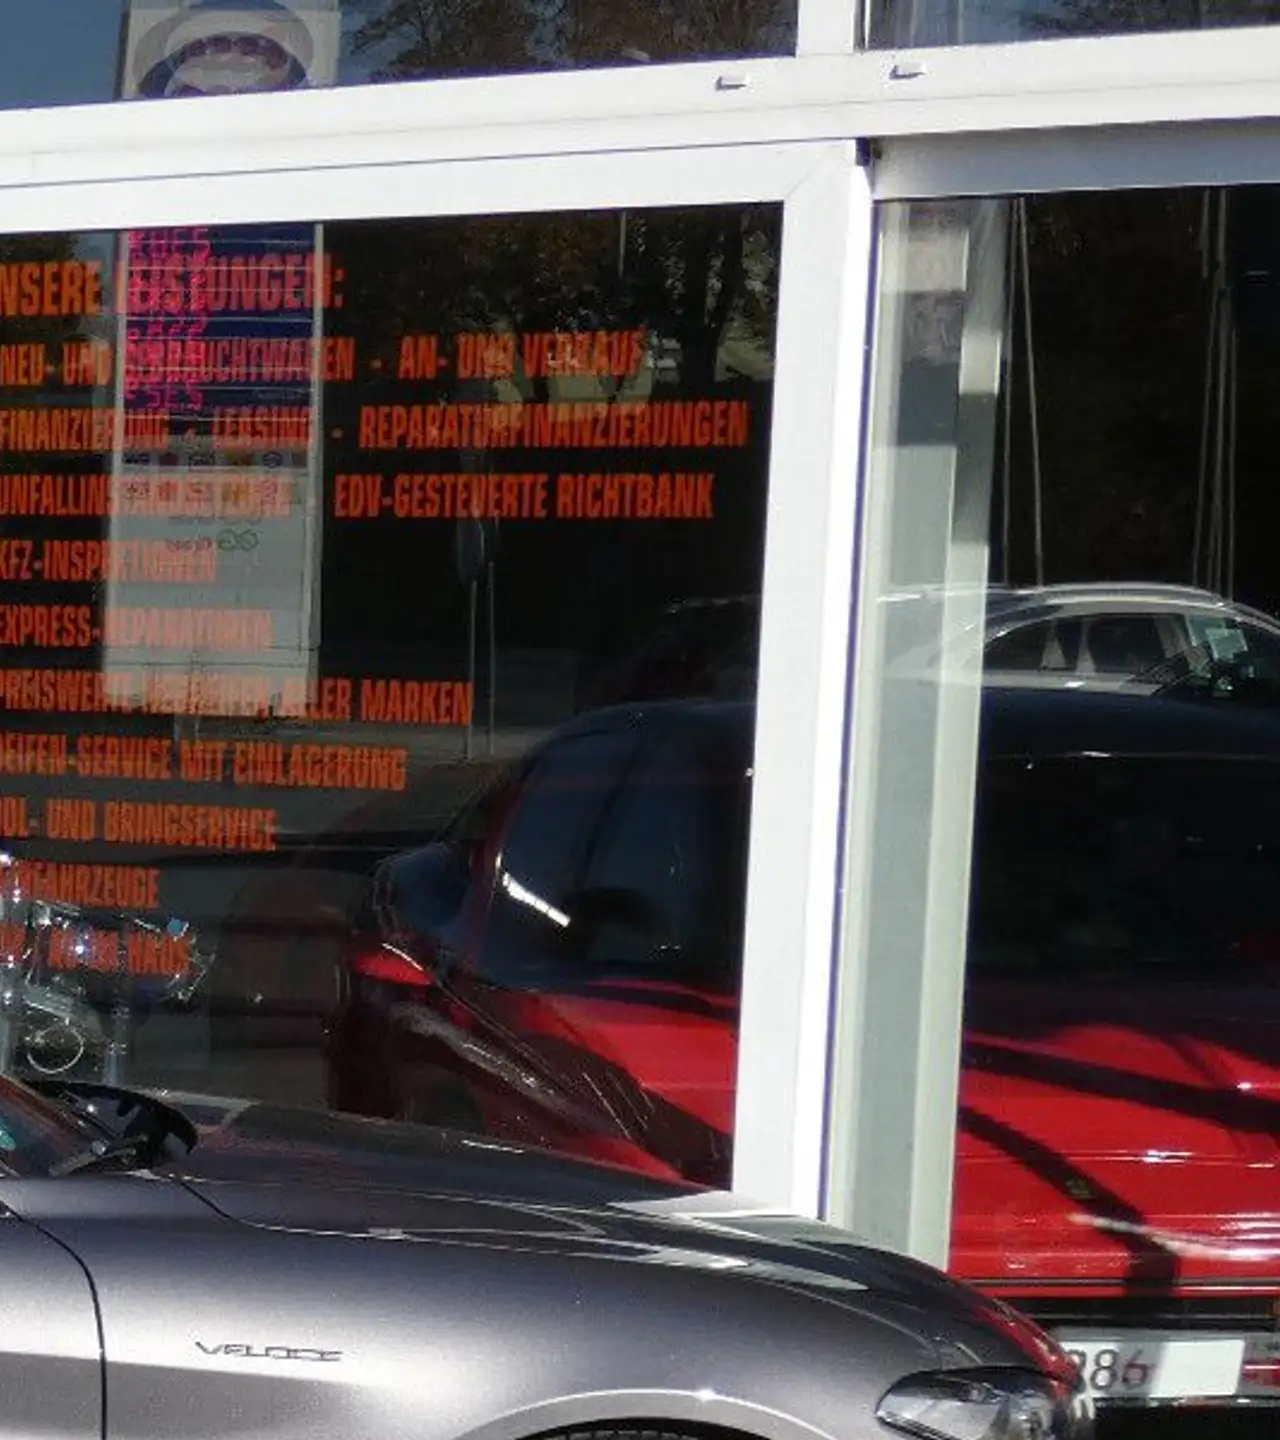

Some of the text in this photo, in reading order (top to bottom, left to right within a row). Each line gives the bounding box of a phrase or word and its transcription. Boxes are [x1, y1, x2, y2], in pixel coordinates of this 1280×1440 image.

[63, 340, 112, 385] UND
[397, 334, 448, 380] AN-
[457, 332, 517, 380] UND
[334, 472, 549, 519] EDV-GESTEUERTE
[556, 472, 717, 519] RICHTBANK
[361, 679, 474, 725] MARKEN
[233, 741, 408, 791] EINLAGERUNG
[46, 797, 96, 841] UND
[103, 801, 277, 851] BRINGSERVICE
